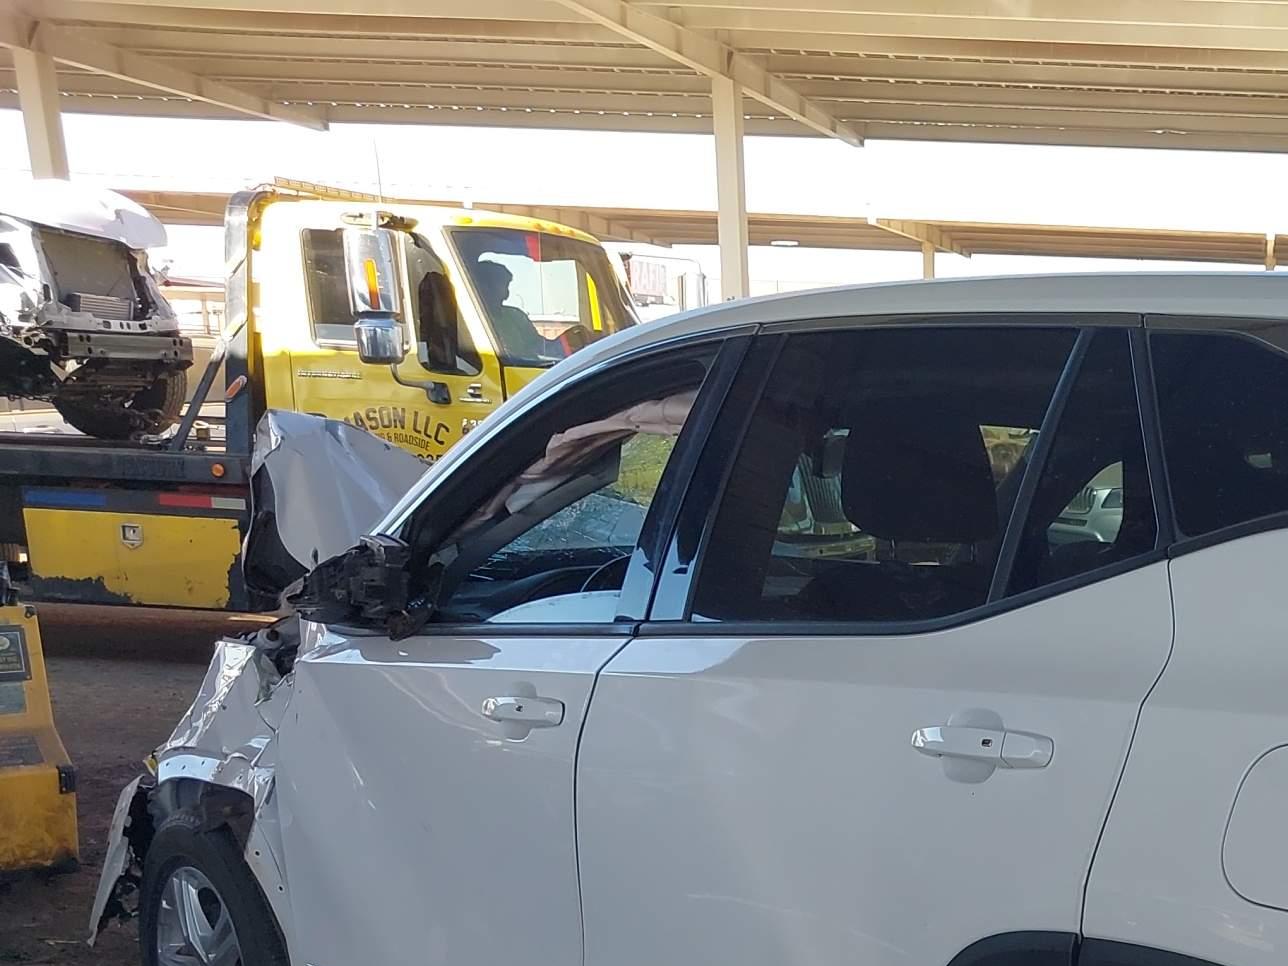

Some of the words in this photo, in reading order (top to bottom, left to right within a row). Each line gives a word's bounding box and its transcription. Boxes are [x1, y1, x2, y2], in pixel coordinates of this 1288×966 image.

[344, 406, 406, 432] ASON
[413, 410, 450, 445] LLC
[393, 432, 431, 451] ROADSIDE
